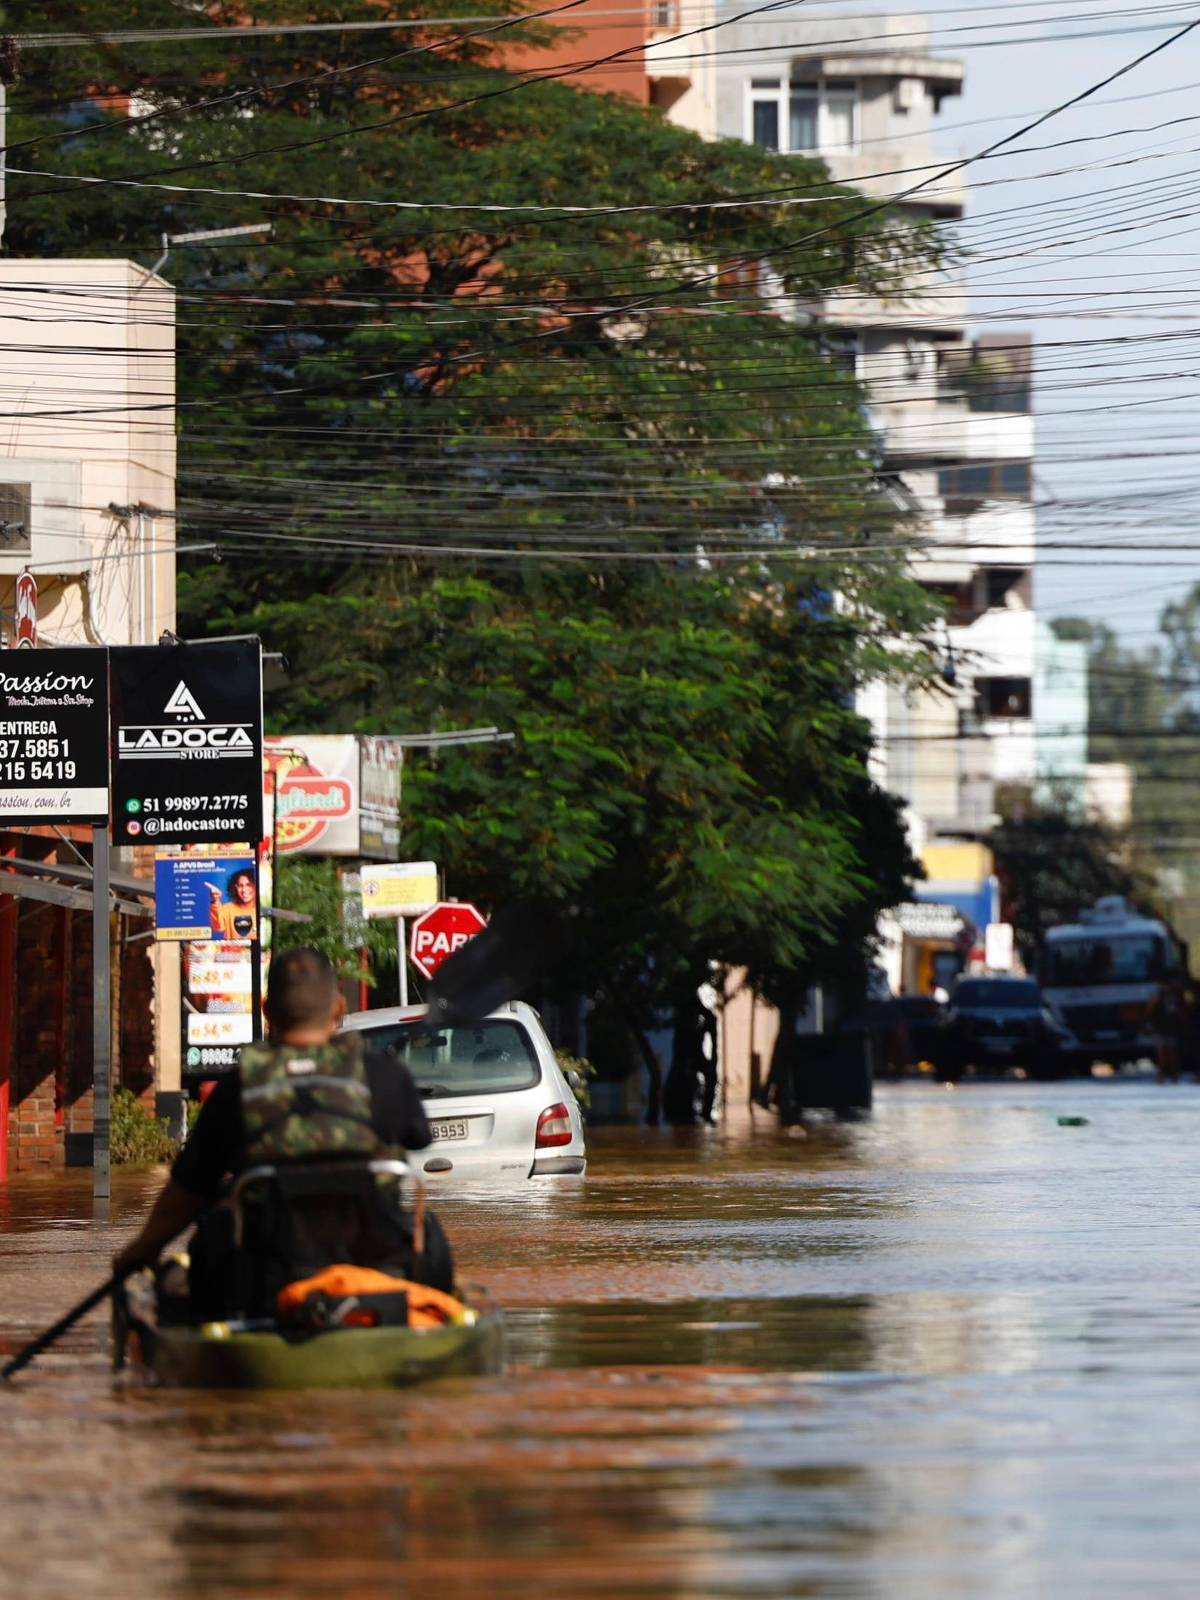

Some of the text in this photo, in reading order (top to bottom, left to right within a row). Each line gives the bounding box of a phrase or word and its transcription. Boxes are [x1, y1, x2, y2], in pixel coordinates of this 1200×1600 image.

[0, 721, 57, 735] ENTREGA
[119, 728, 253, 748] LADOCA
[180, 749, 220, 760] STORE
[31, 761, 76, 780] 5419
[143, 795, 248, 812] 51 99897.2775
[143, 817, 245, 836] @ladocastore
[417, 931, 475, 953] PAR
[432, 1124, 465, 1138] 8953
